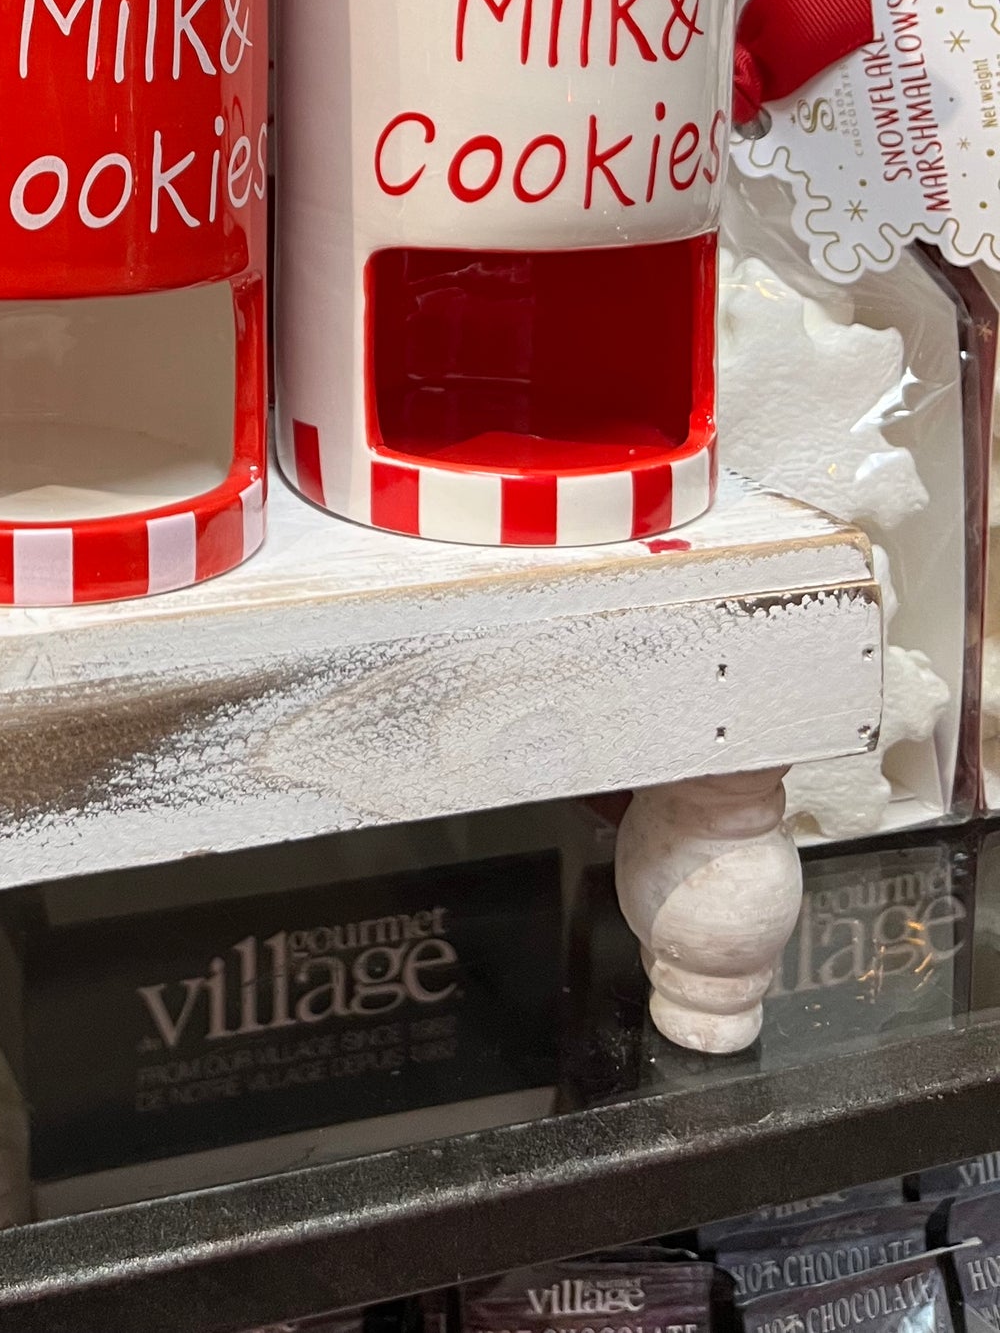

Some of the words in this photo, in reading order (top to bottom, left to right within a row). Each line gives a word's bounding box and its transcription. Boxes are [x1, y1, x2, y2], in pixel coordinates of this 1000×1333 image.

[972, 58, 993, 103] weight
[374, 101, 726, 210] Cookies
[137, 929, 458, 1048] village
[526, 1278, 645, 1314] village
